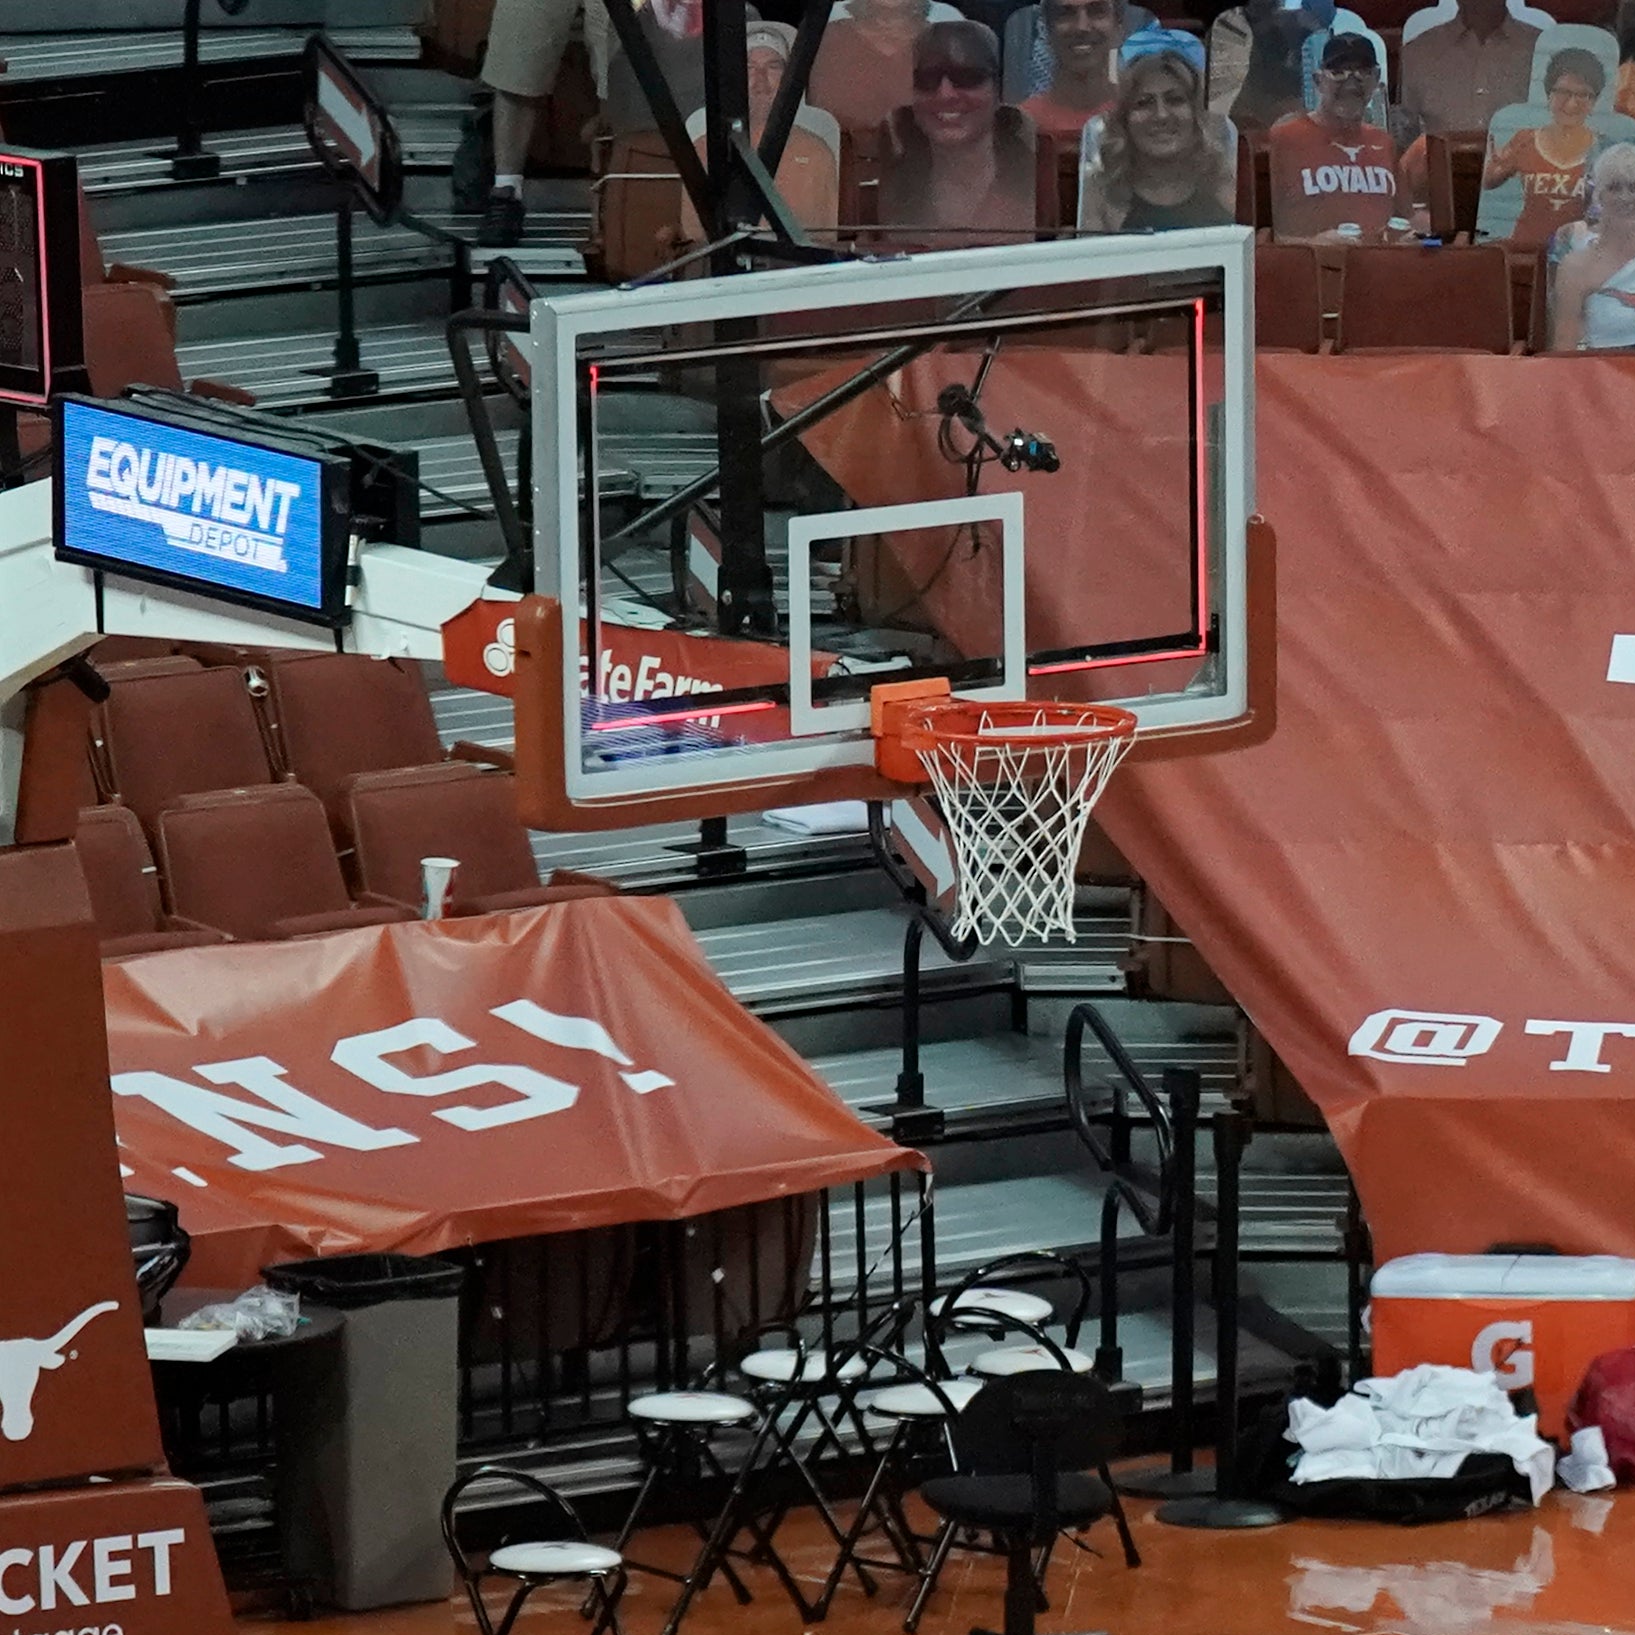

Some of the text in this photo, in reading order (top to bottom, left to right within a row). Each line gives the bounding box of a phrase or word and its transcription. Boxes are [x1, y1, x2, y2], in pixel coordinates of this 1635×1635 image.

[1523, 172, 1592, 199] TEXA
[86, 435, 301, 535] EQUIPMENT
[187, 522, 262, 560] DEPOT
[110, 998, 677, 1178] NS!
[1471, 1320, 1534, 1391] G
[0, 1528, 186, 1615] CKET
